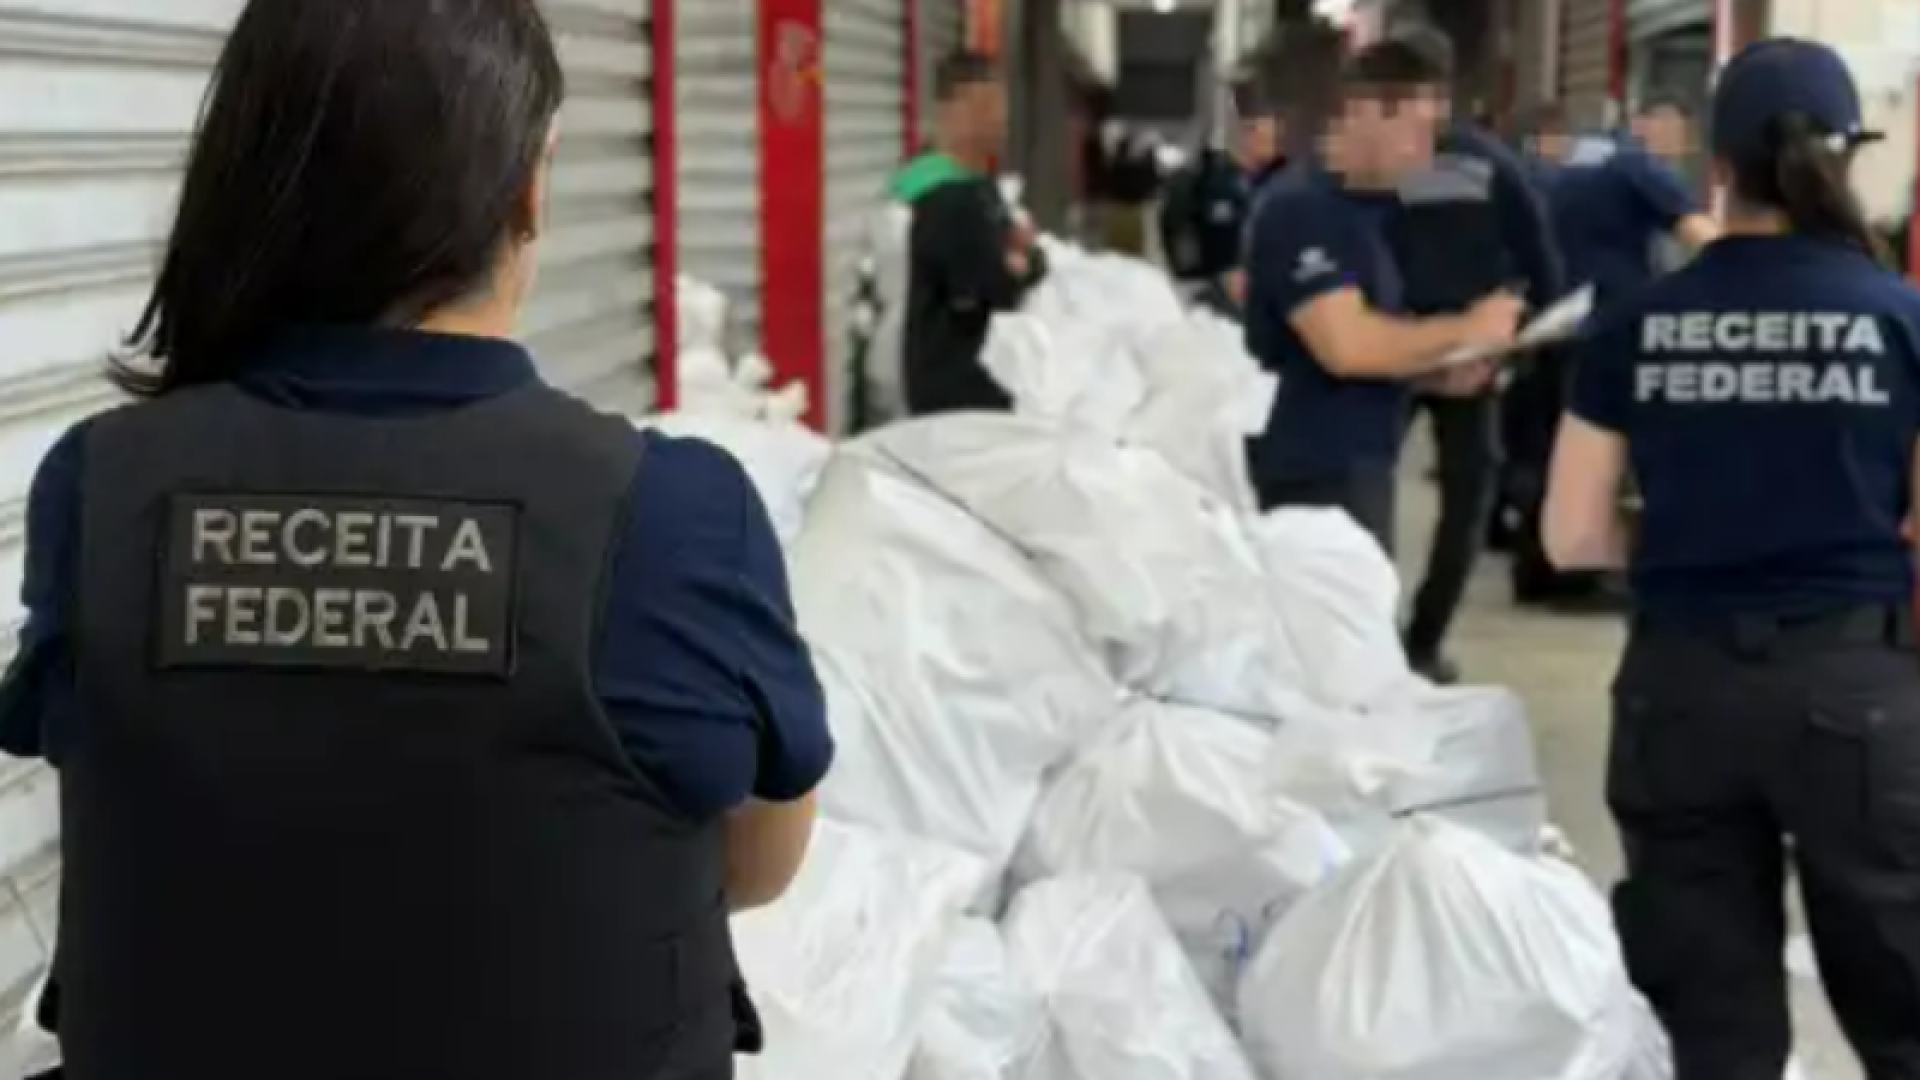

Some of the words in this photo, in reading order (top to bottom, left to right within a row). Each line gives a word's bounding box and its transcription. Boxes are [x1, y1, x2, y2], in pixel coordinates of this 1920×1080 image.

[1643, 312, 1885, 355] RECEITA
[1635, 363, 1889, 404] FEDERAL
[192, 508, 492, 572] RECEITA
[184, 586, 488, 652] FEDERAL
